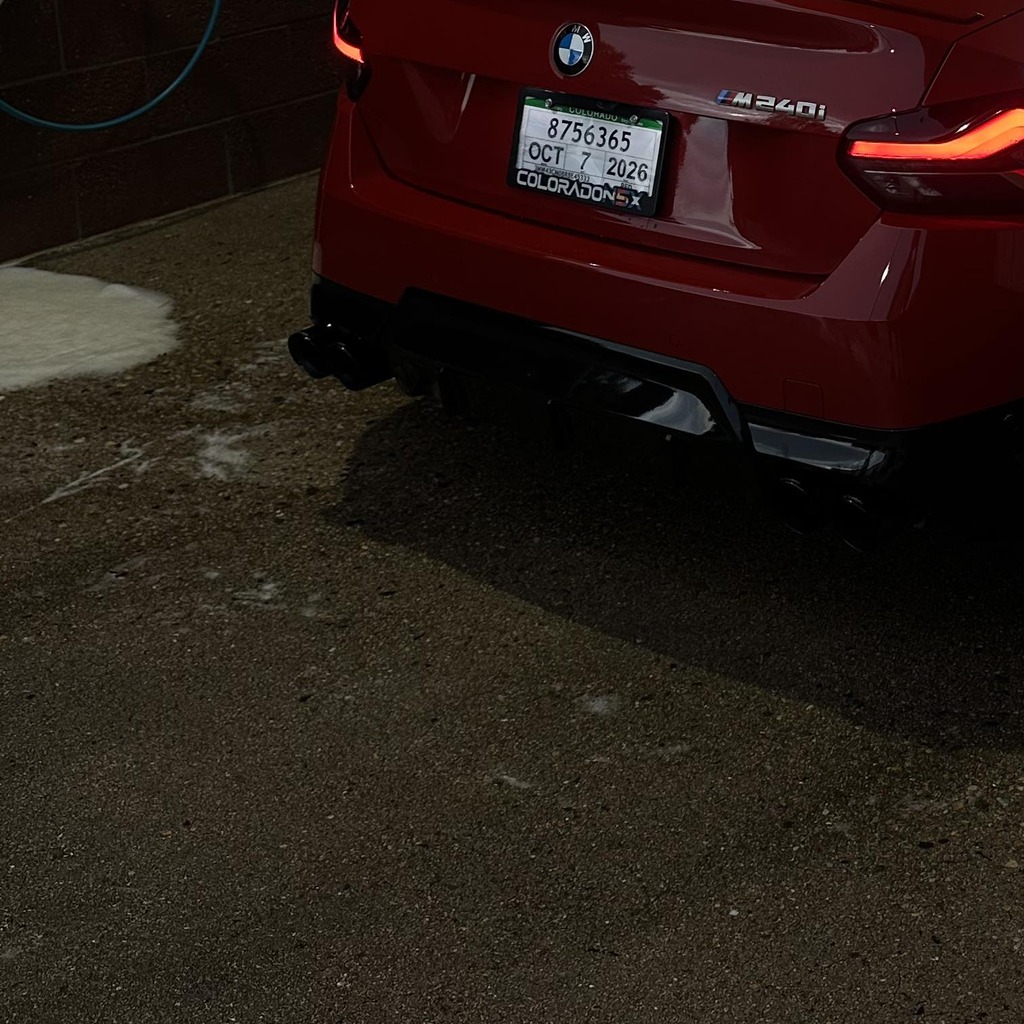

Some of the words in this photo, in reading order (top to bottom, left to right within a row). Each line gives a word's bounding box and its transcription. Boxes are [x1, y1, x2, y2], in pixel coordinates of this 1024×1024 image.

[731, 91, 826, 121] M240i
[547, 118, 632, 153] 8756365
[528, 141, 564, 165] OCT
[581, 151, 592, 170] 7
[606, 156, 648, 182] 2026
